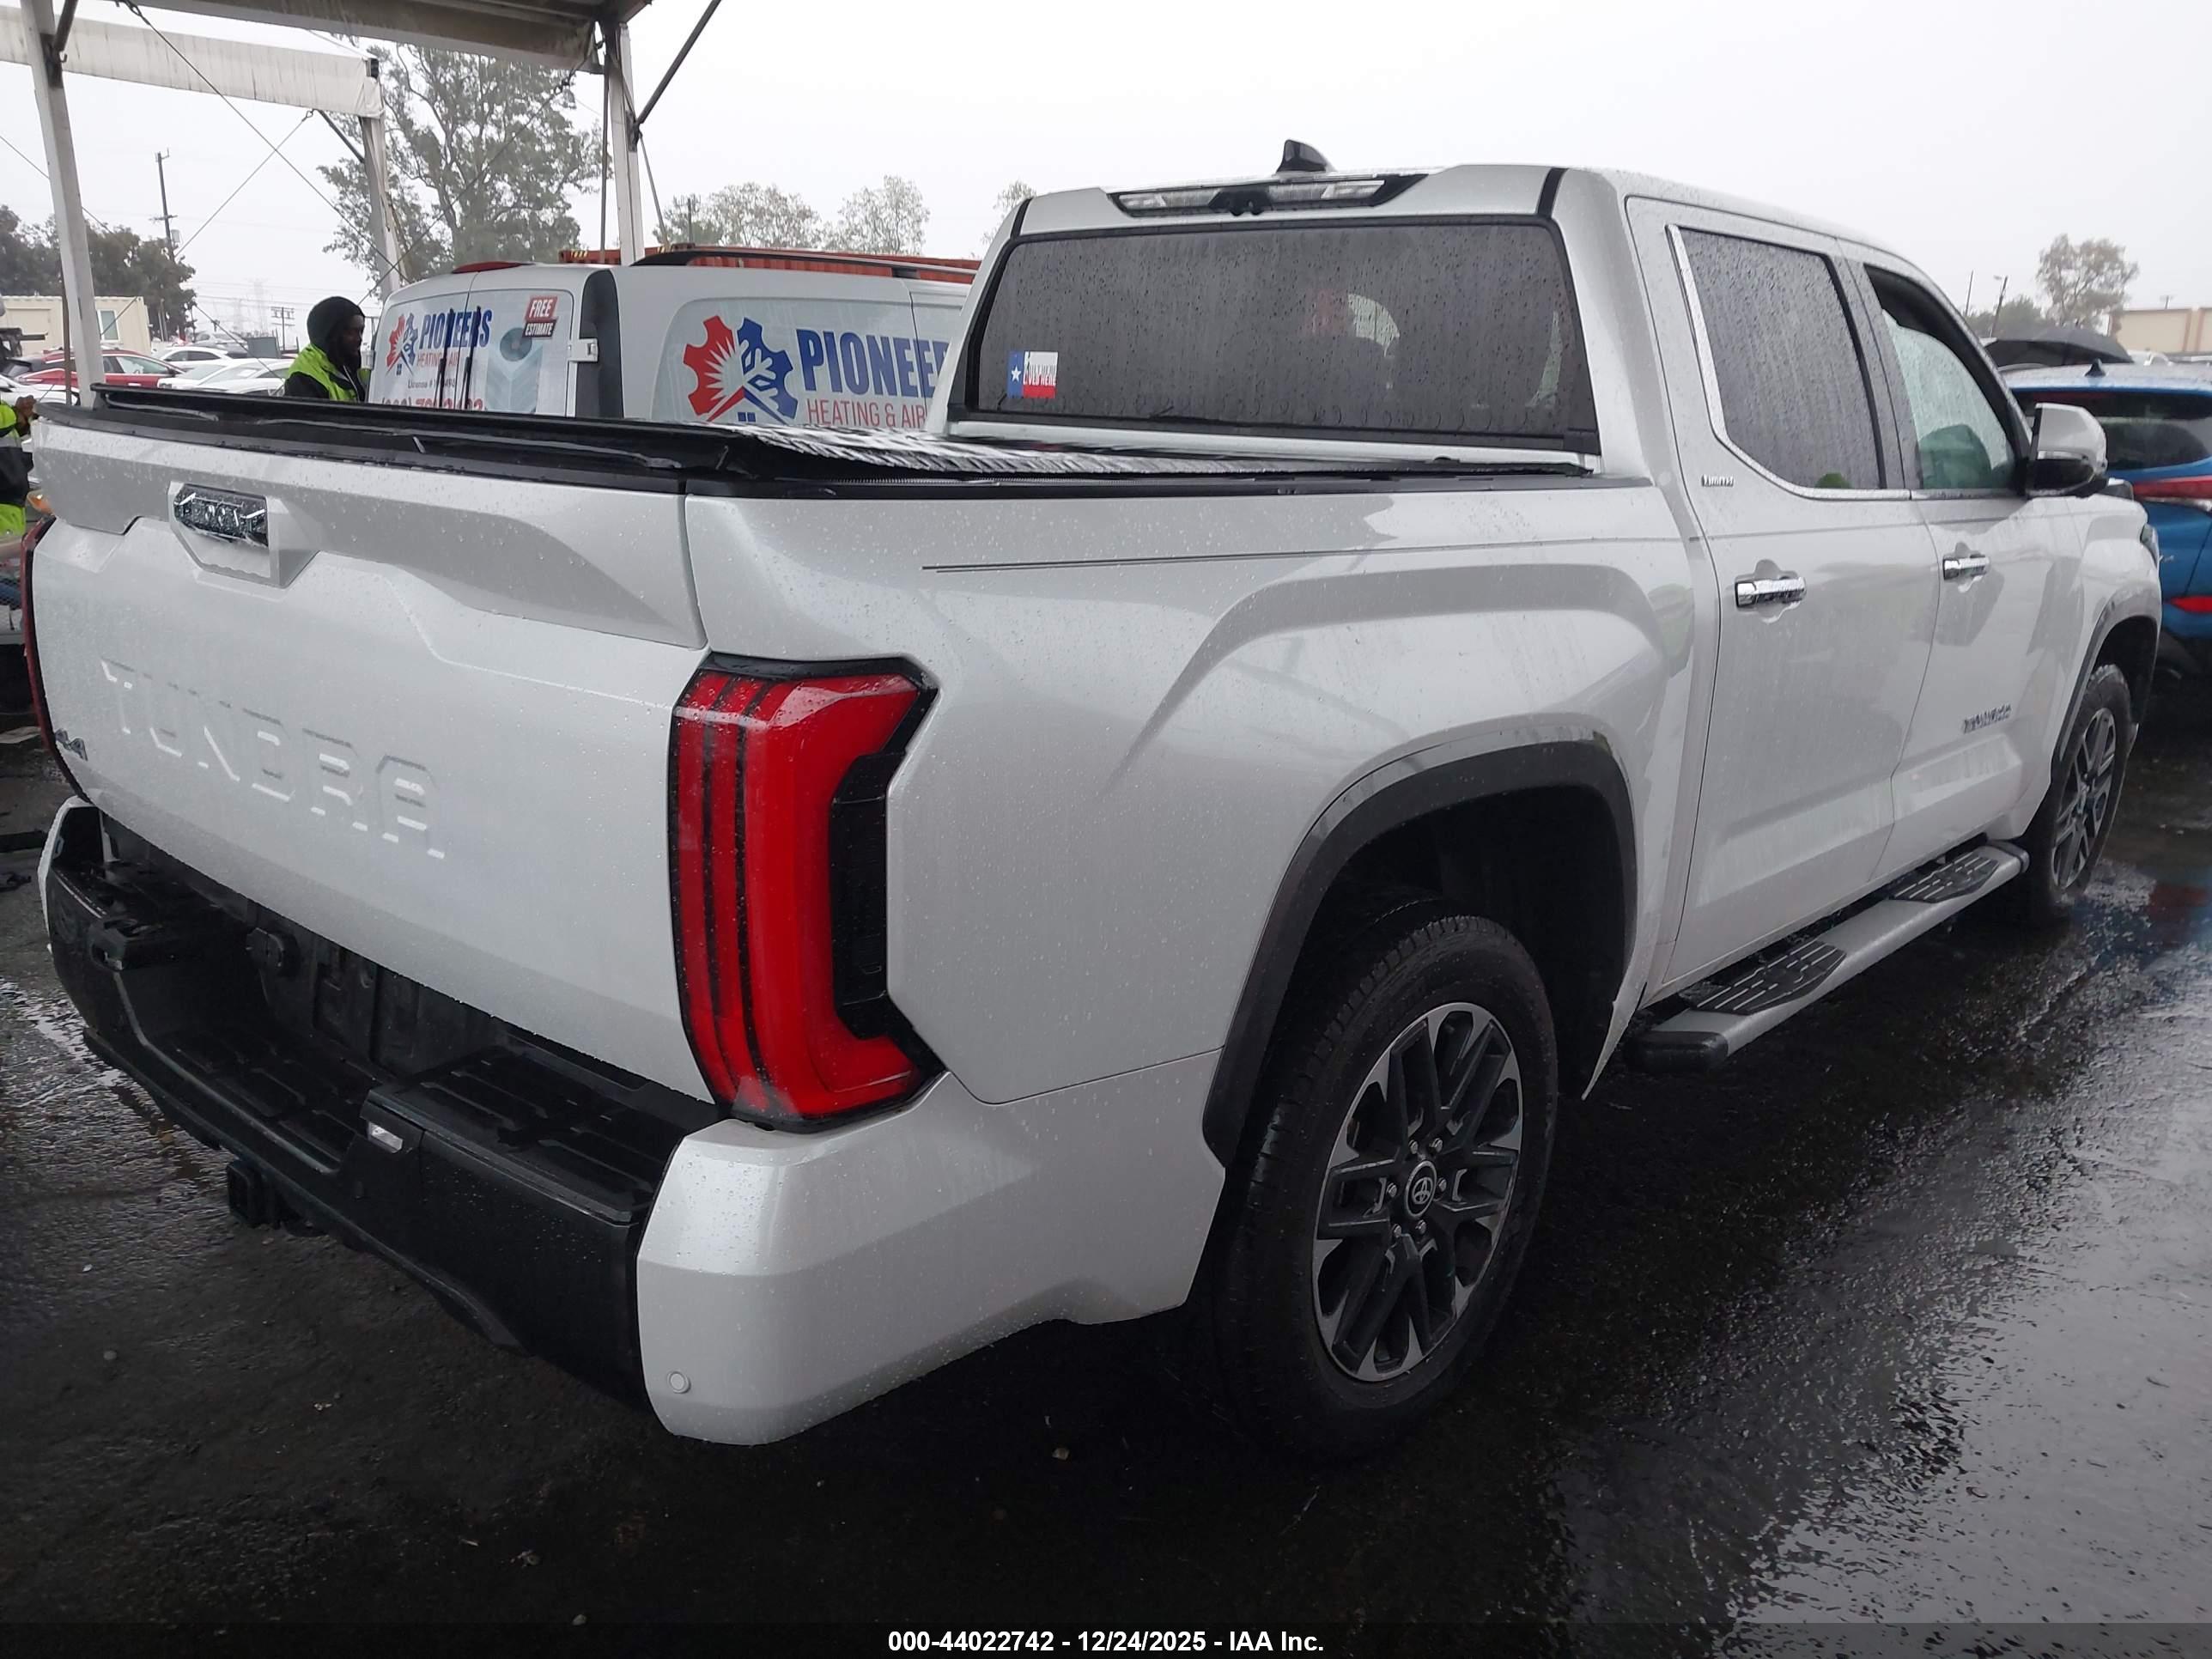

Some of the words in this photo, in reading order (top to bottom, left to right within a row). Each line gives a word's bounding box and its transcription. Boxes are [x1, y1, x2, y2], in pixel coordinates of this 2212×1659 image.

[528, 299, 554, 318] FREE
[418, 308, 493, 349] PIOEES
[525, 322, 554, 336] ESTIMATE
[806, 398, 881, 427] HEATING
[884, 402, 896, 427] &
[901, 404, 927, 428] AIR
[99, 654, 447, 860] TUNDRA
